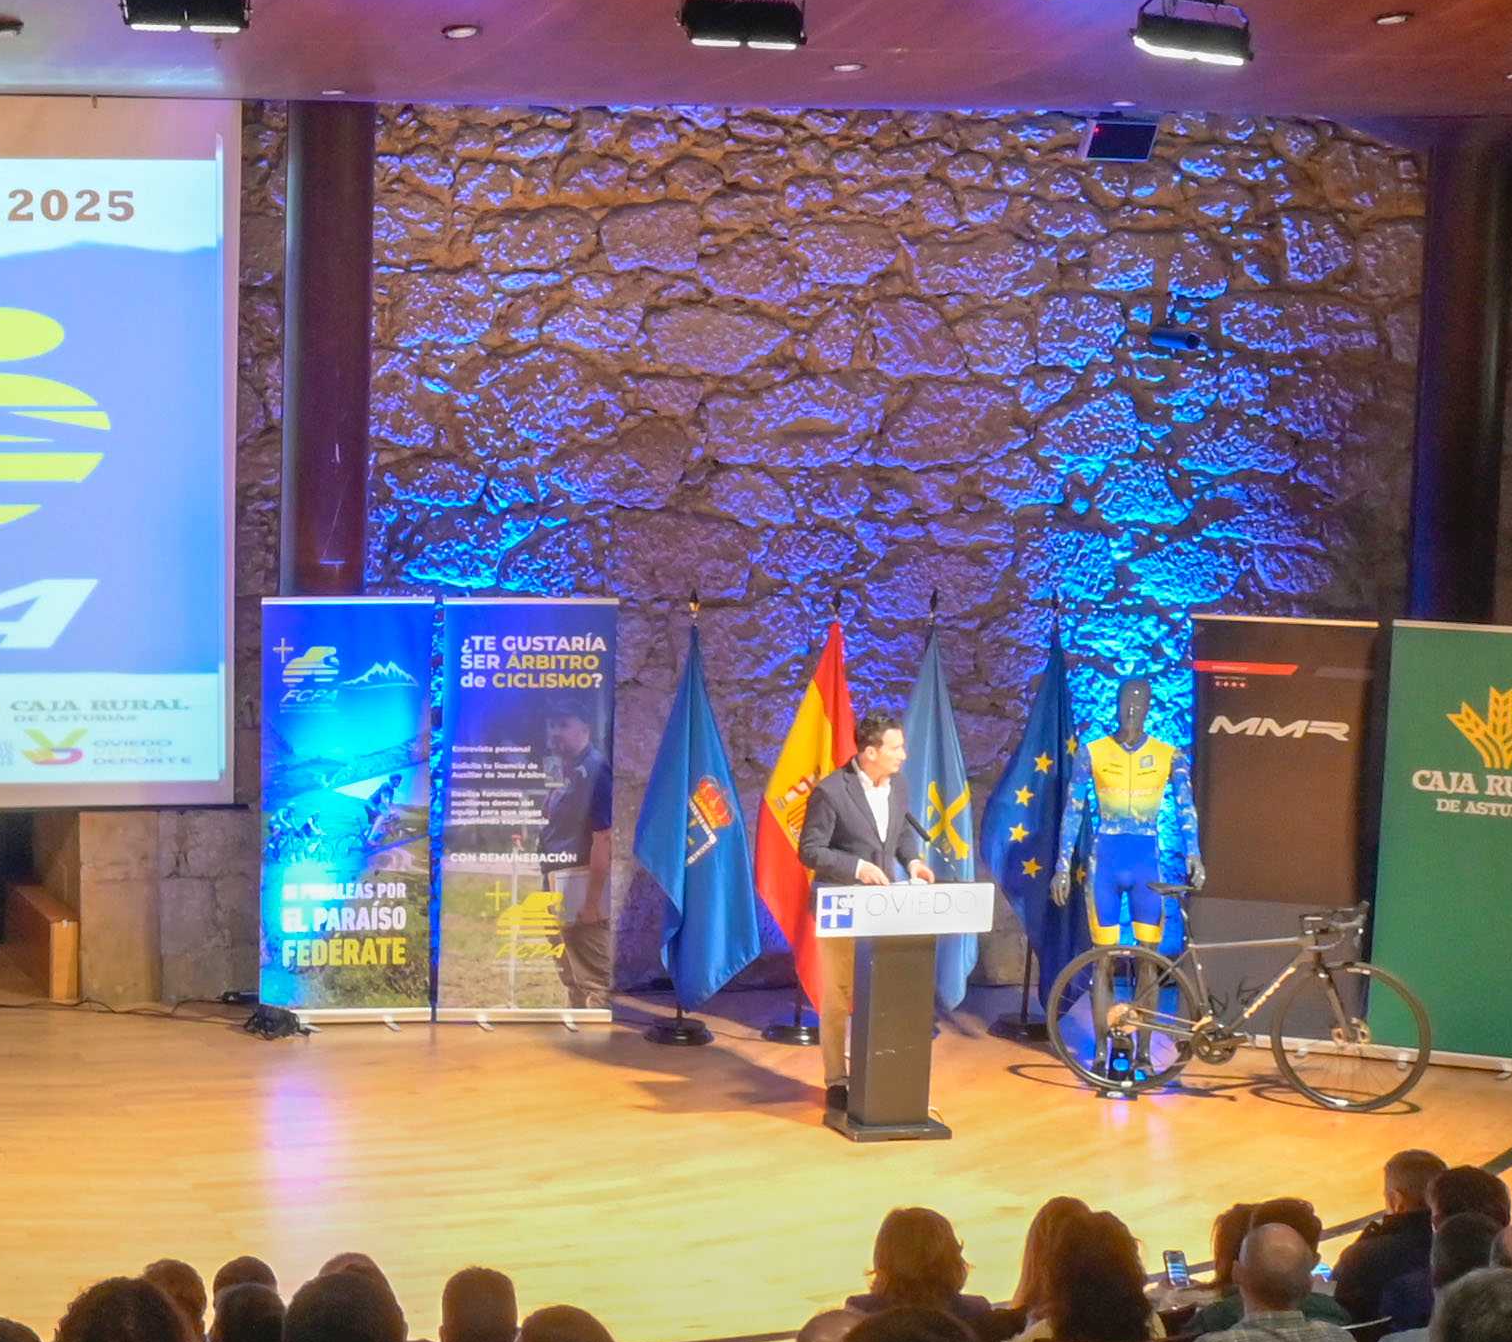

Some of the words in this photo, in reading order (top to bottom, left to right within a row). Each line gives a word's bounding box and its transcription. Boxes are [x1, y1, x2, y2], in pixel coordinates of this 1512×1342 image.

[7, 188, 136, 222] 2025
[461, 635, 497, 654] ¿TE
[502, 632, 607, 652] GUSTARÍA
[460, 654, 500, 670] SER
[506, 651, 600, 670] ÁRBITRO
[460, 672, 486, 688] de
[492, 672, 604, 689] CICLISMO?
[1208, 715, 1351, 742] MMR
[1412, 769, 1479, 795] CAJA
[1436, 798, 1462, 813] DE
[450, 853, 477, 863] CON
[479, 850, 578, 863] REMUNERACIÓN
[377, 882, 407, 899] POR
[865, 890, 978, 917] OVIEDO
[313, 900, 407, 932] PARAÍSO
[282, 932, 408, 968] FEDÉRATE
